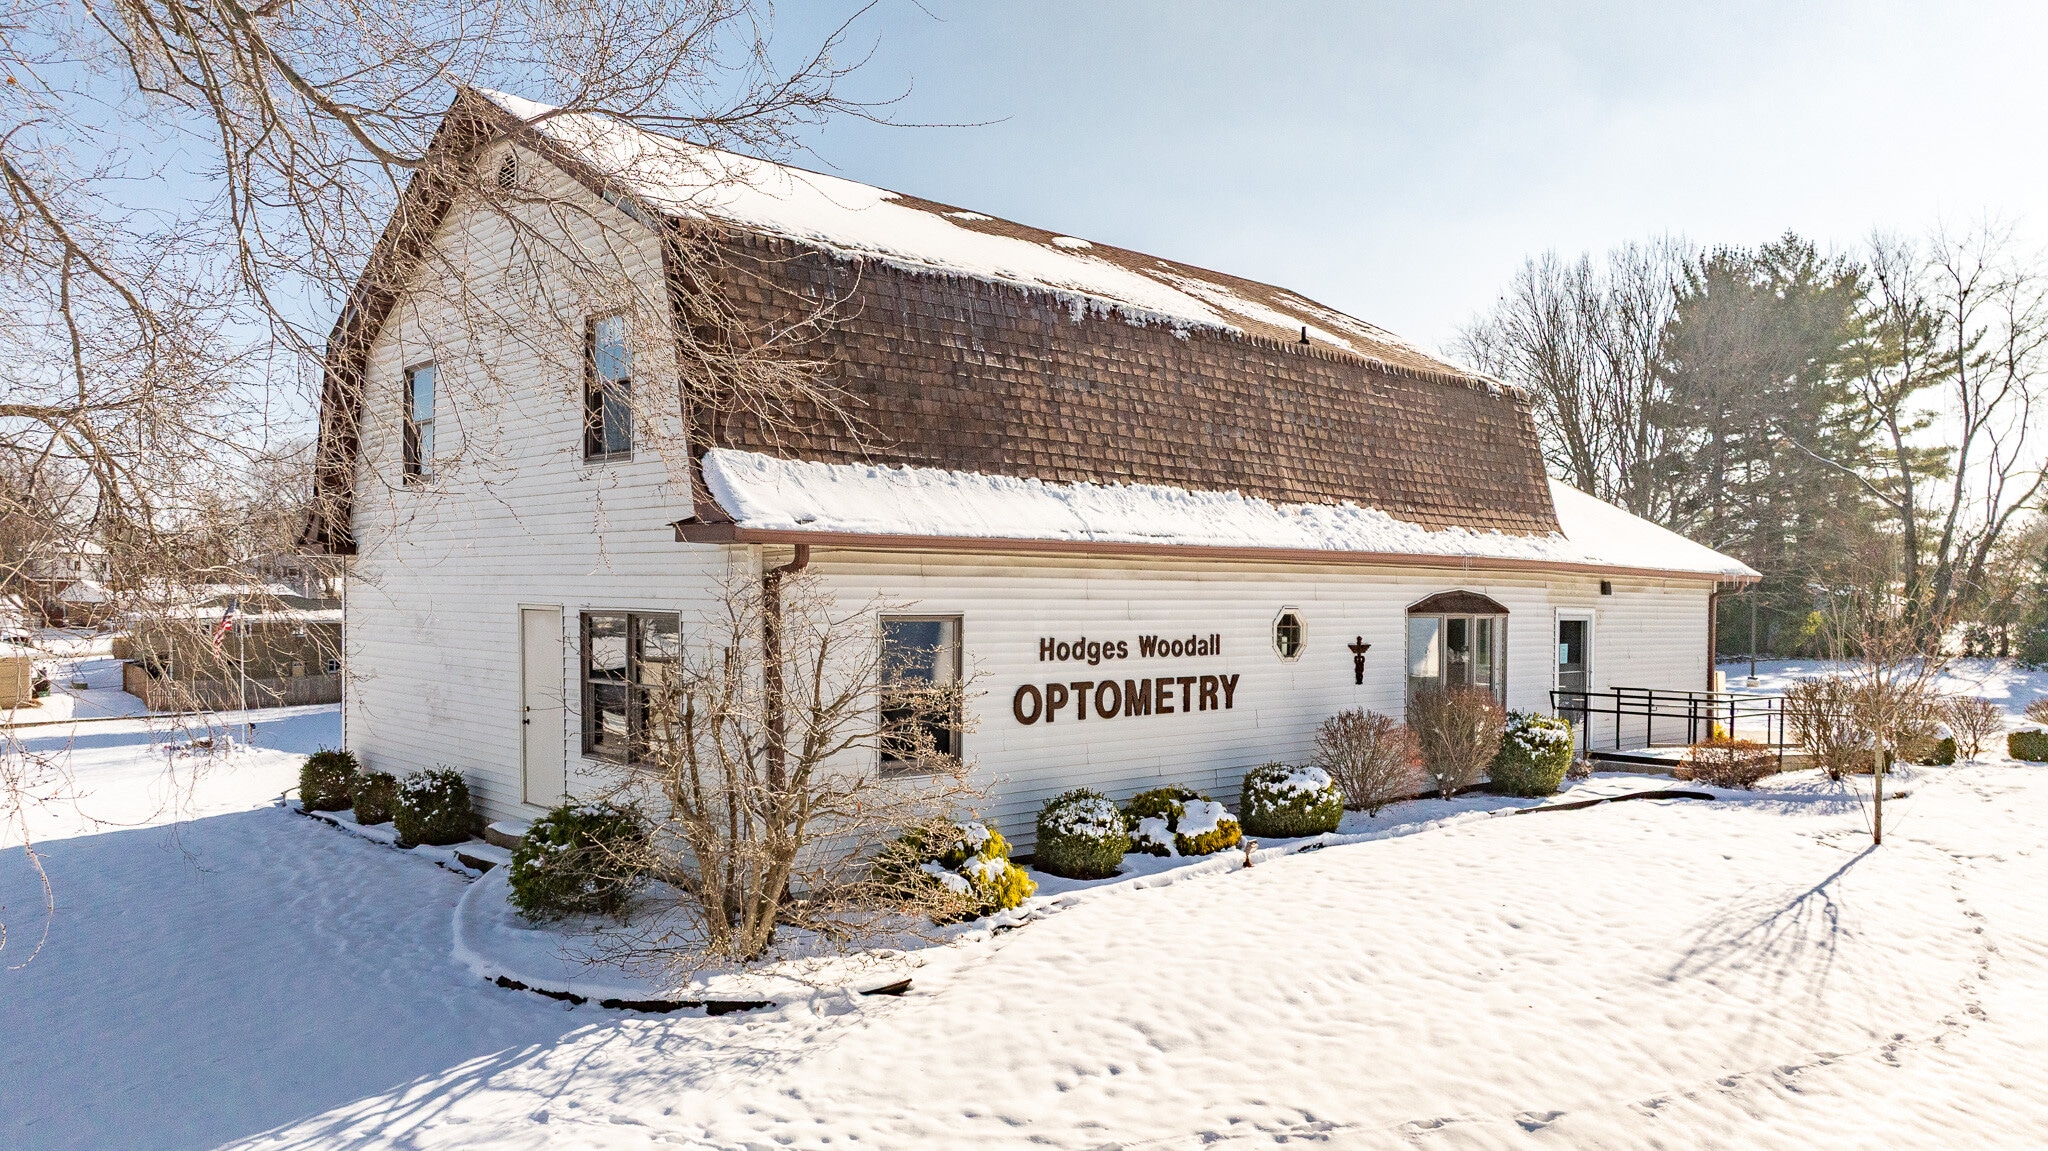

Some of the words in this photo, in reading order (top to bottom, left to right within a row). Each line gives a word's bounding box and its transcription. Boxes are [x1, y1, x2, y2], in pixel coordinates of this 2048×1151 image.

[1039, 636, 1129, 666] Hodges
[1138, 633, 1221, 658] Woodall
[1013, 673, 1240, 726] OPTOMETRY
